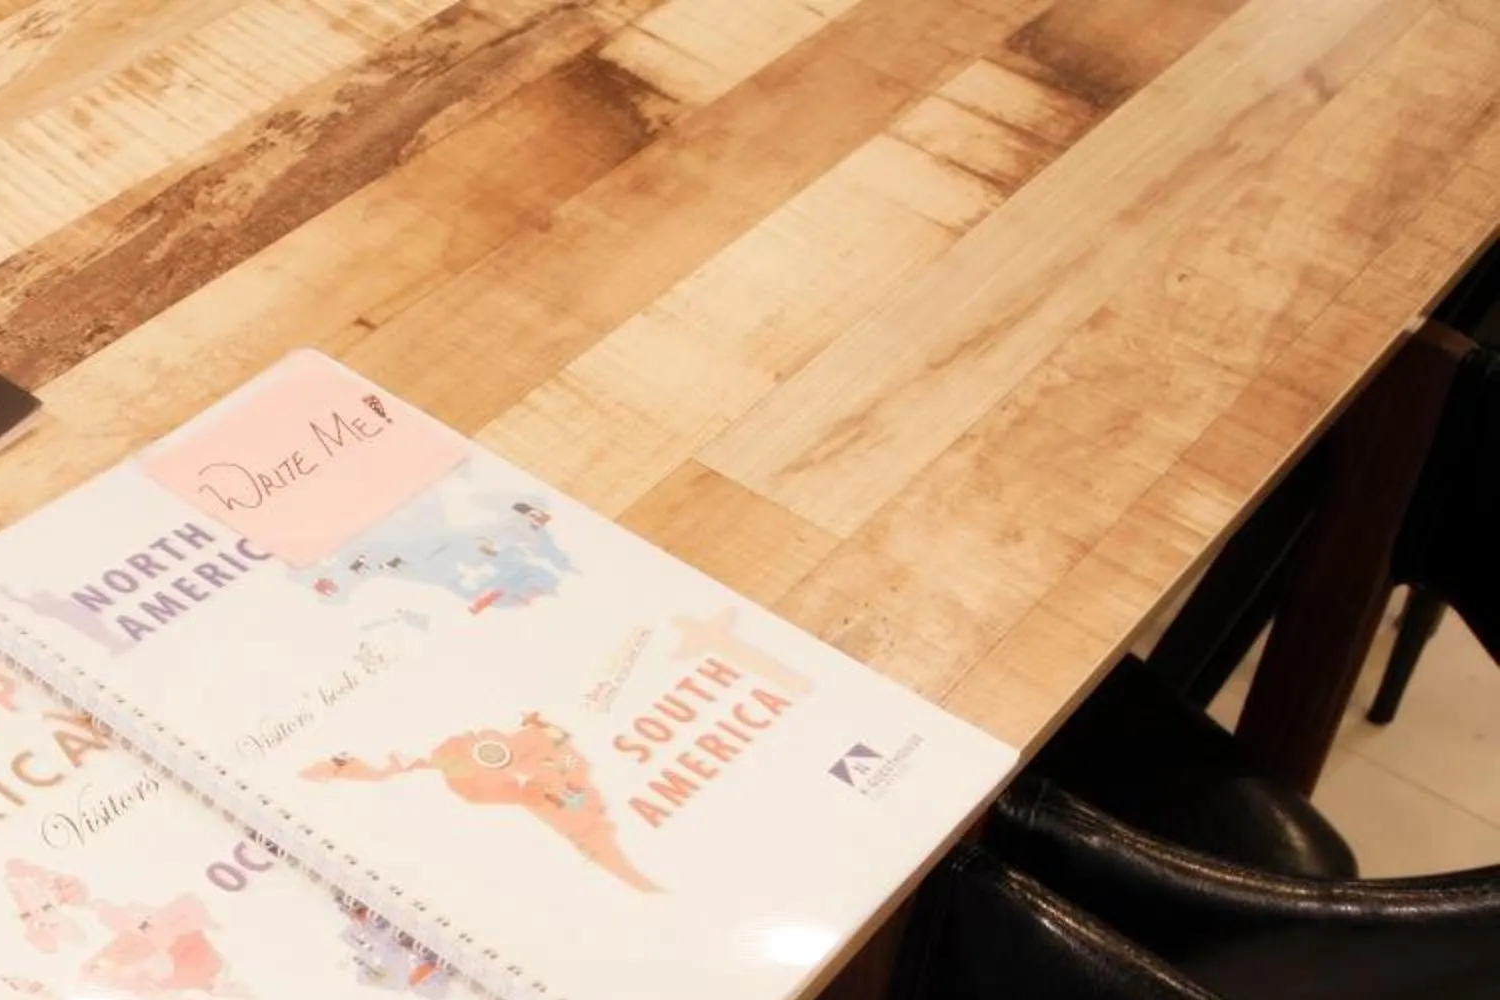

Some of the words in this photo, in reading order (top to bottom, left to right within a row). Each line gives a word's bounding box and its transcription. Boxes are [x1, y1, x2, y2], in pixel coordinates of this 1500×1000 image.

[198, 450, 318, 511] WRITE
[70, 521, 217, 613] NORTH
[116, 537, 274, 642] AMERIC
[612, 656, 741, 765] SOUTH
[627, 686, 793, 829] AMERICA
